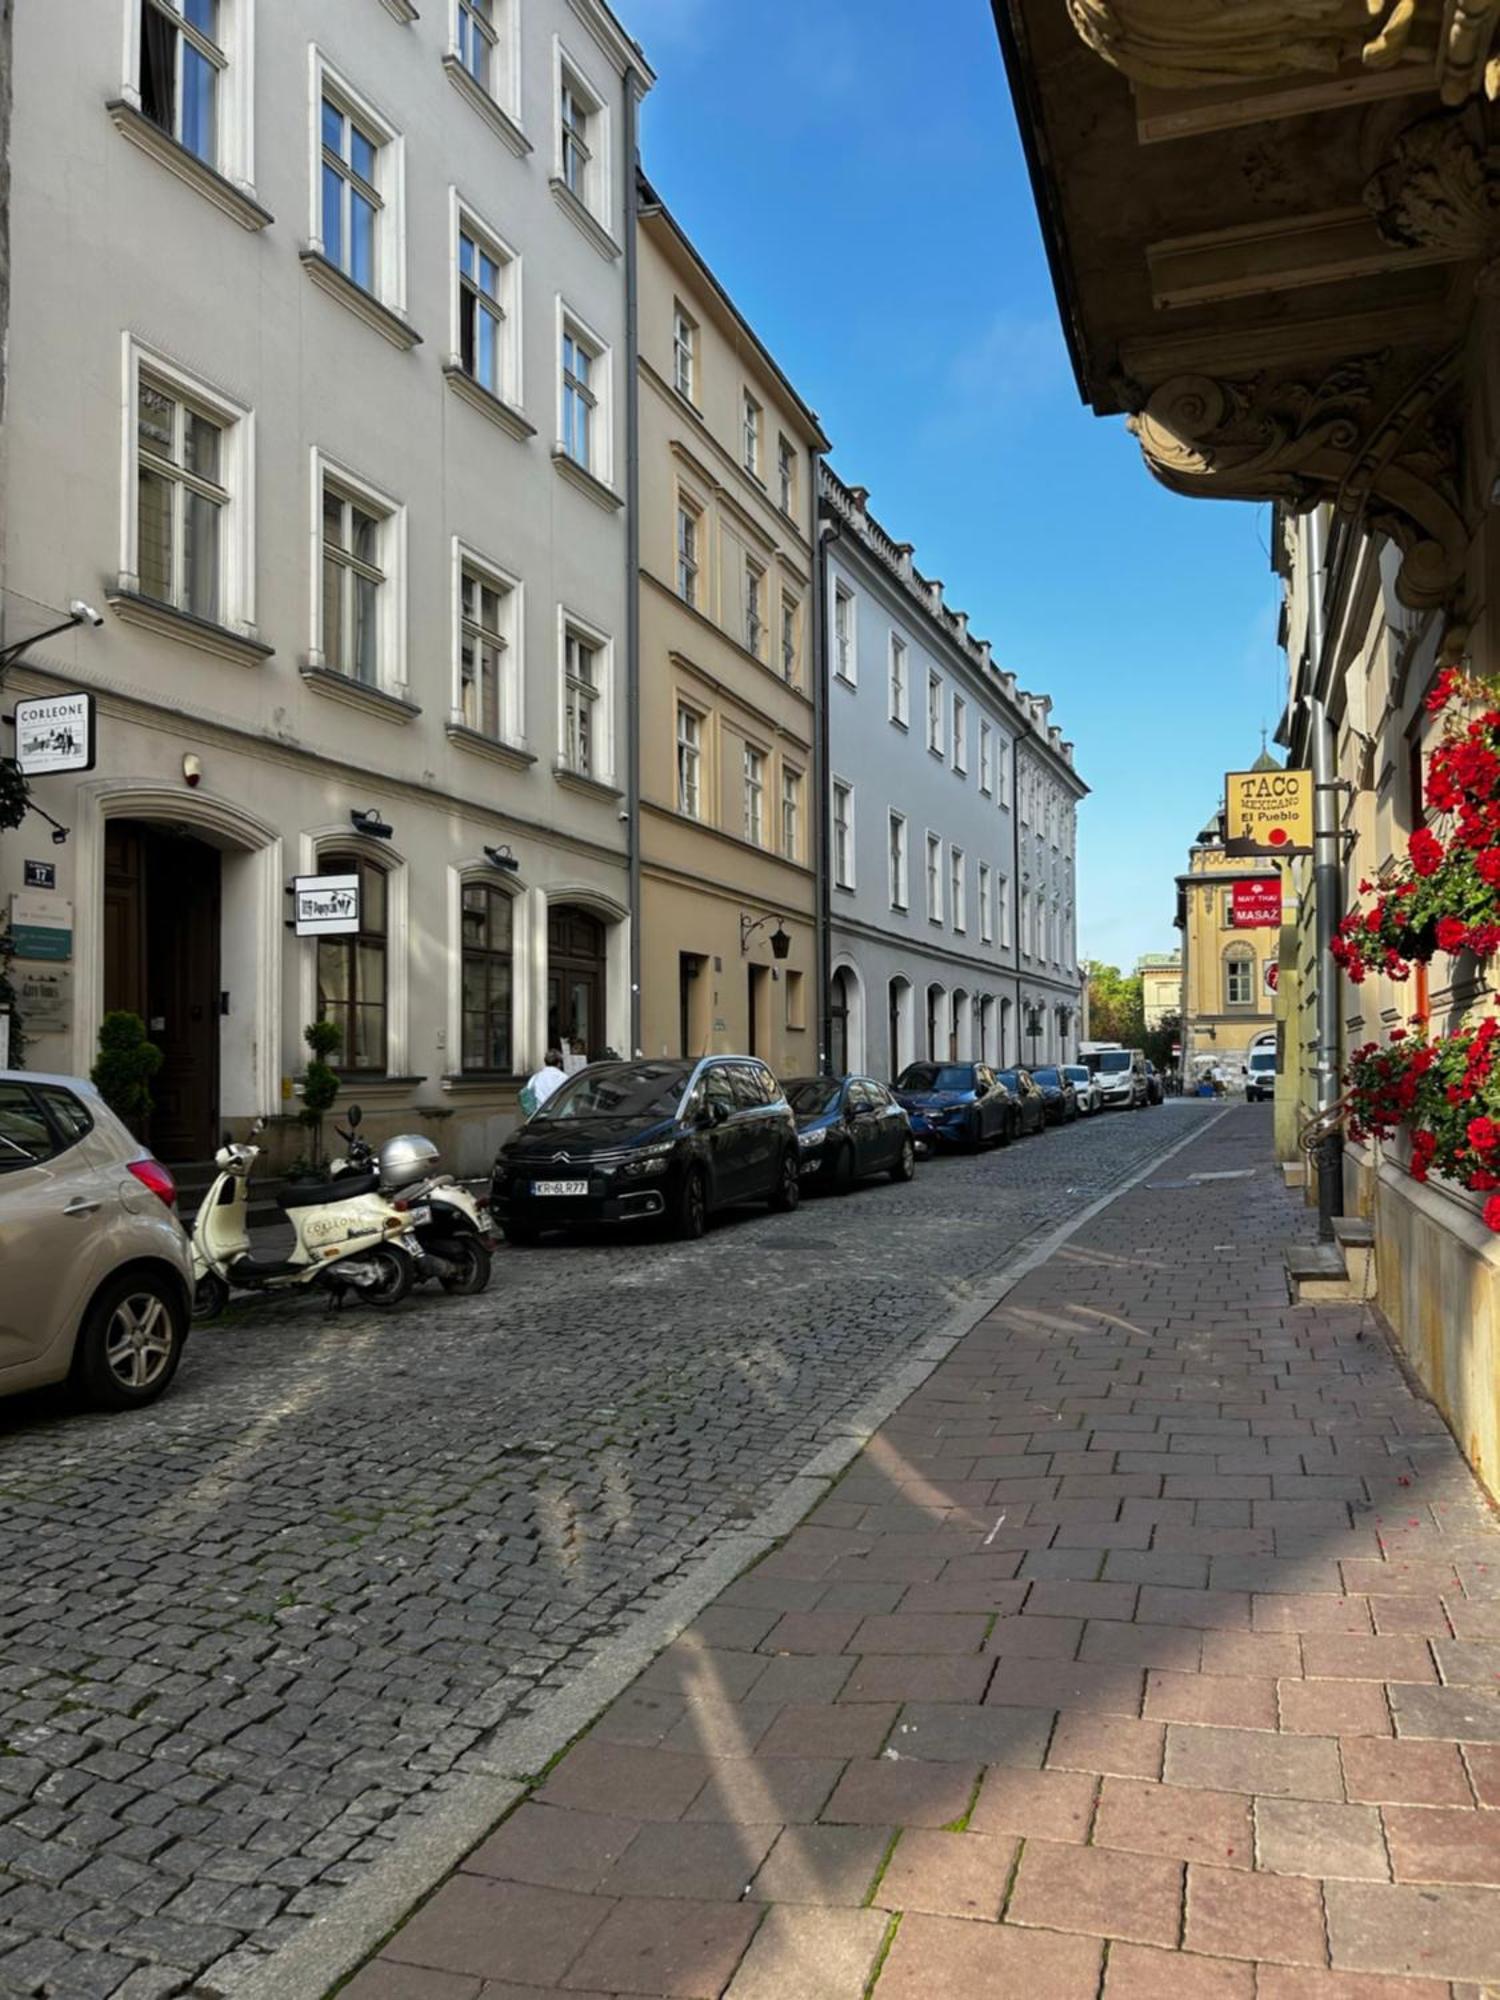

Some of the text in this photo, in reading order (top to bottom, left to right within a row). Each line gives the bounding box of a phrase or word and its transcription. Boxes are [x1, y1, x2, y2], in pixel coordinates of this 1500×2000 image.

[21, 704, 83, 721] CORLEONE
[1241, 777, 1299, 798] TACO
[1241, 811, 1299, 822] El Pueblo
[36, 869, 46, 880] 17
[1237, 895, 1255, 903] MAY
[1236, 909, 1279, 921] MASAŻ
